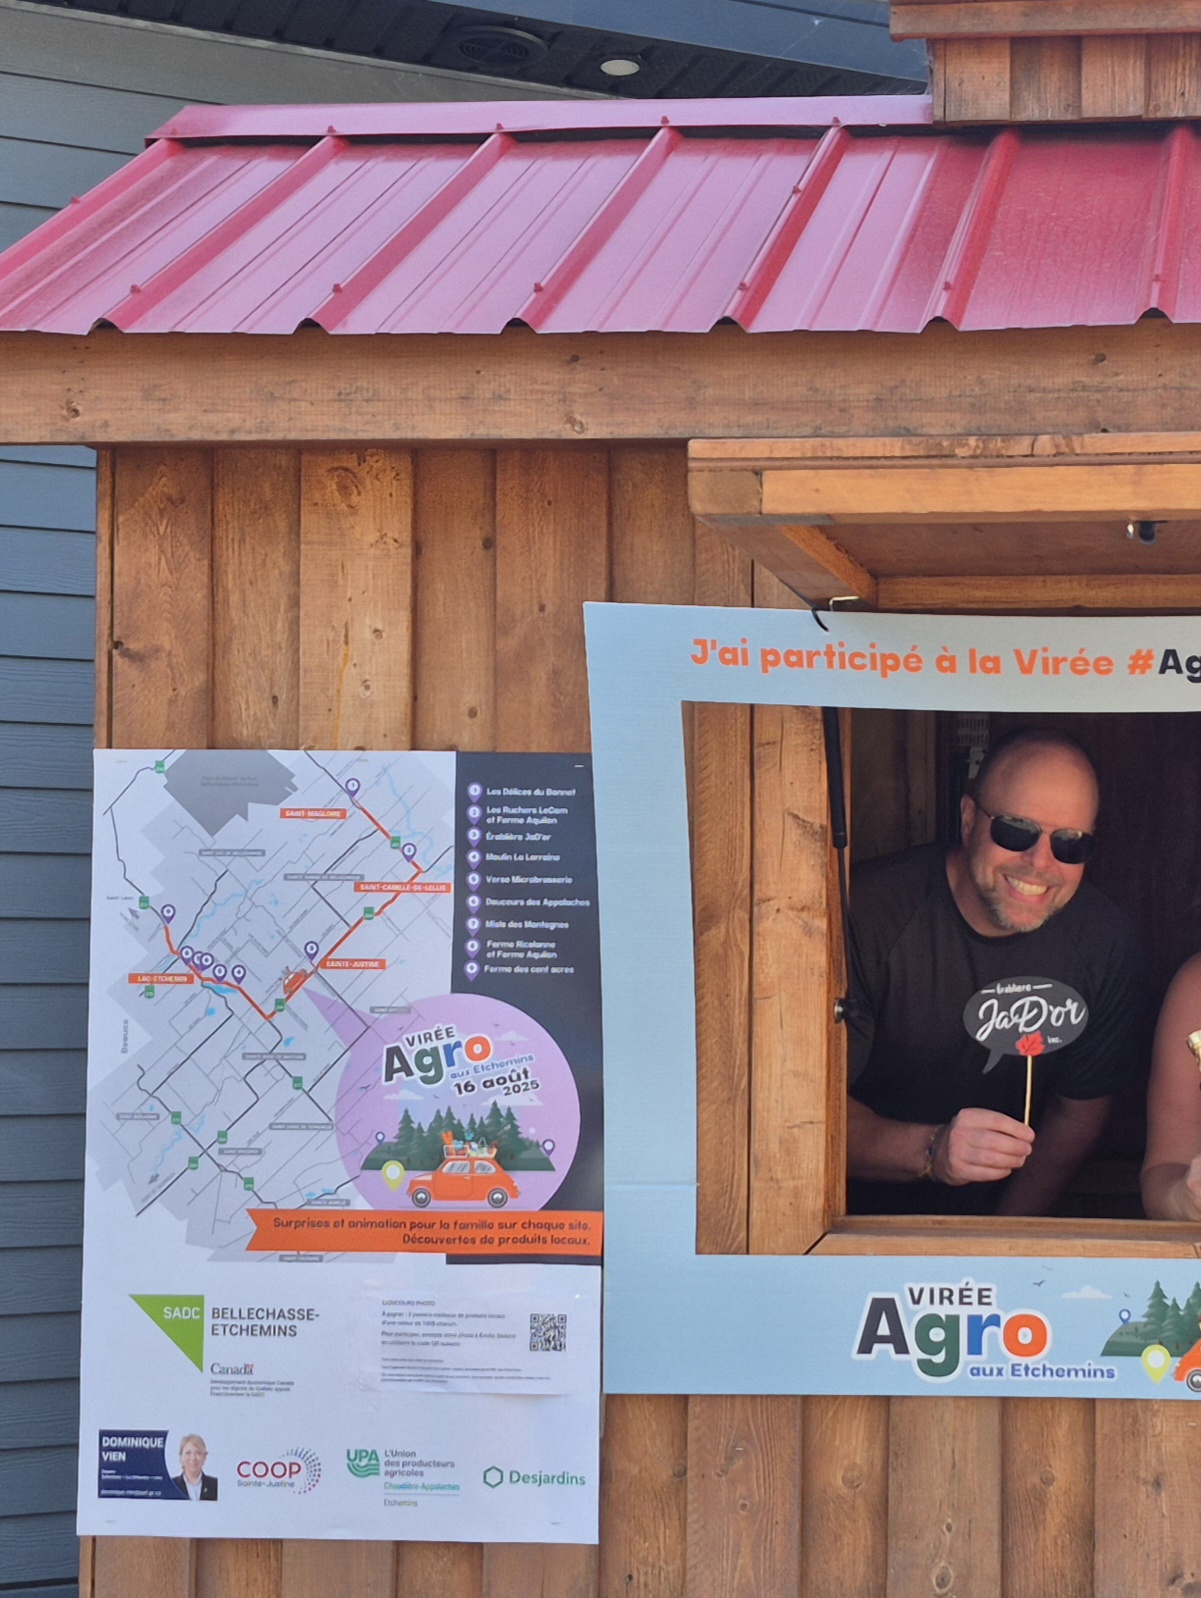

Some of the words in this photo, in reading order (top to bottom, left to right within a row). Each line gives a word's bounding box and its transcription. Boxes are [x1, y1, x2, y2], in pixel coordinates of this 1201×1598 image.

[690, 638, 748, 666] J'ai
[760, 641, 924, 678] participé
[935, 645, 958, 674] à
[969, 648, 1002, 674] la
[1012, 646, 1114, 676] Virée
[406, 1026, 456, 1048] VIRÉE
[384, 1036, 491, 1085] Agro
[450, 1070, 470, 1079] aux
[474, 1054, 534, 1074] Etchemins
[454, 1080, 476, 1096] 16
[482, 1067, 530, 1090] août
[503, 1080, 540, 1096] 2025
[274, 1218, 330, 1230] Surprises
[334, 1218, 344, 1228] et
[348, 1218, 406, 1229] animation
[410, 1220, 436, 1230] pour
[440, 1220, 450, 1230] la
[454, 1220, 494, 1230] famille
[498, 1221, 518, 1230] sur
[521, 1220, 565, 1232] chaque
[403, 1234, 476, 1245] Découvertes
[480, 1234, 494, 1245] de
[498, 1234, 548, 1246] produits
[908, 1282, 993, 1306] VIRÉE
[164, 1306, 200, 1320] SADC
[212, 1308, 320, 1321] BELLECHASSE-
[211, 1324, 297, 1337] ETCHEMINS
[856, 1297, 1048, 1377] Agro
[969, 1364, 1004, 1378] aux
[1010, 1362, 1116, 1380] Etchemins
[102, 1436, 164, 1448] DOMINIQUE
[102, 1452, 126, 1462] VIEN
[347, 1449, 380, 1463] UPA
[384, 1449, 416, 1458] L'Union
[237, 1461, 302, 1478] COOP
[384, 1460, 400, 1468] des
[402, 1460, 455, 1469] producteurs
[384, 1468, 424, 1478] agricoles
[509, 1470, 586, 1487] Desjardins
[238, 1479, 295, 1488] Sainte-Justine
